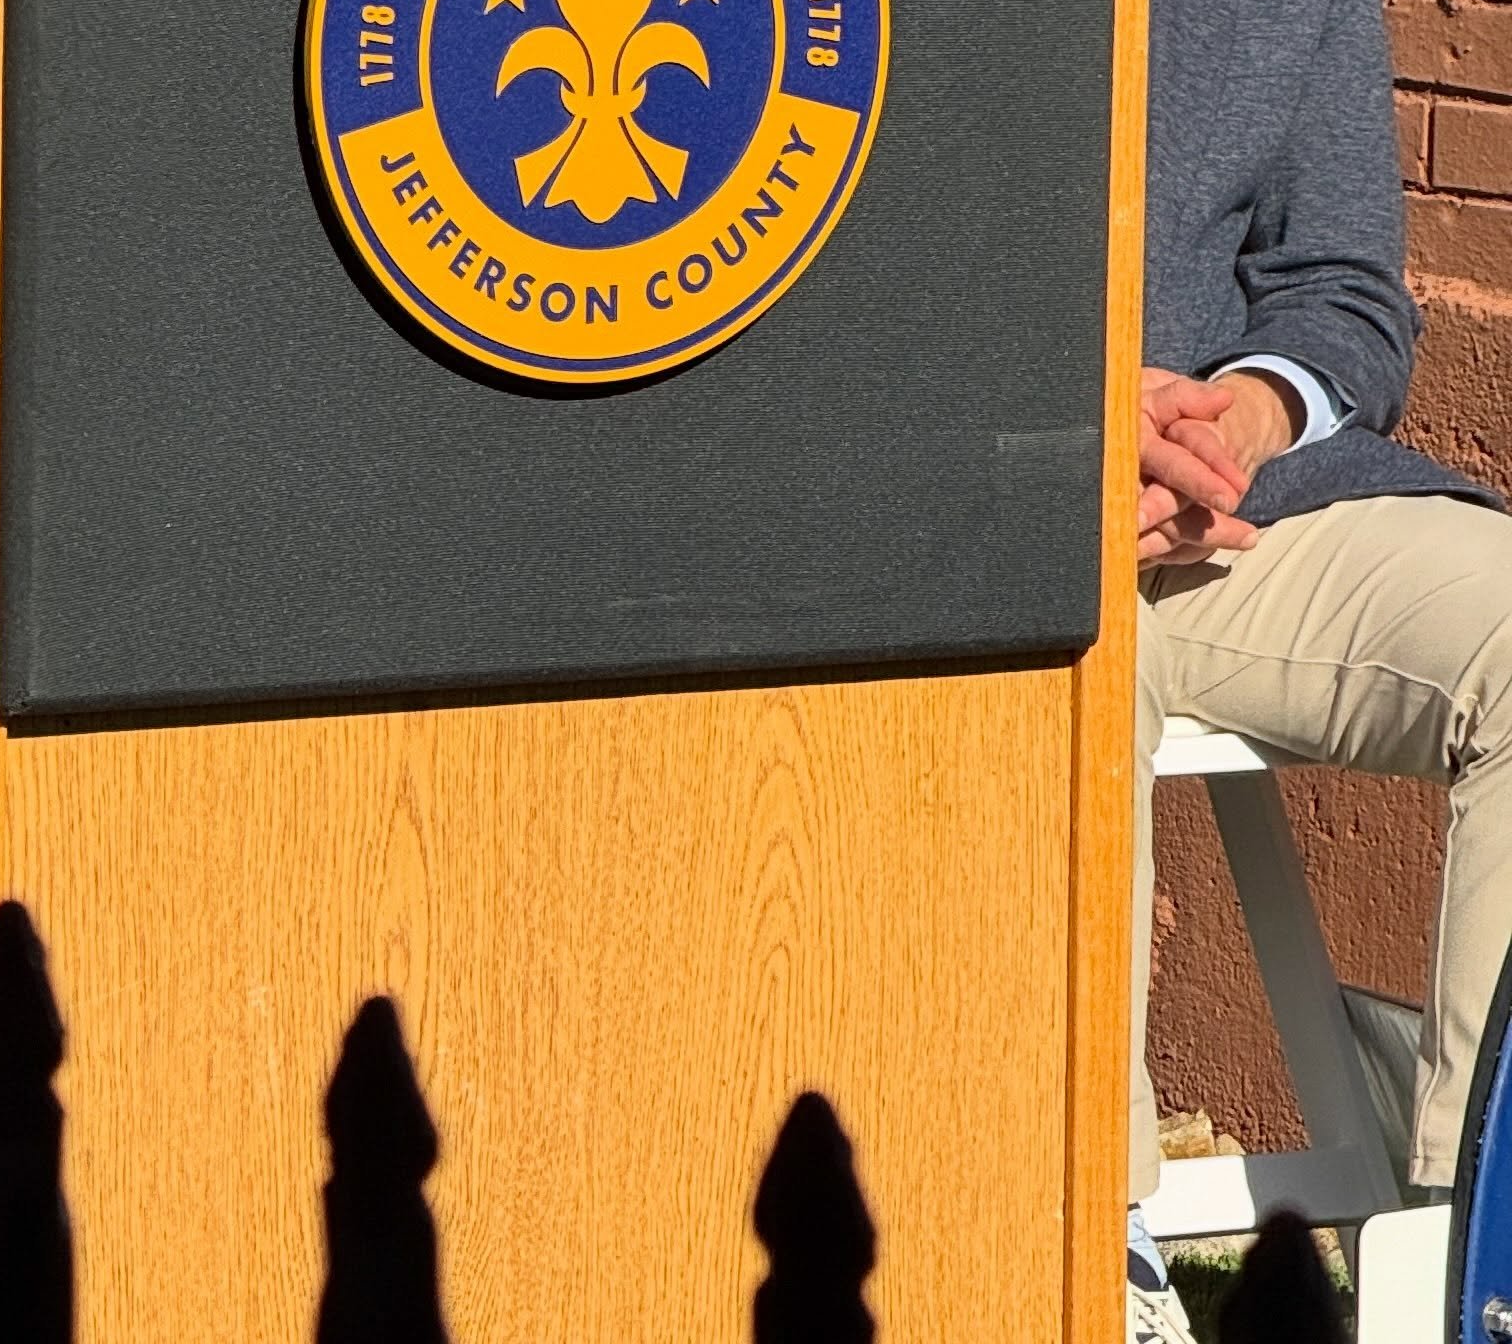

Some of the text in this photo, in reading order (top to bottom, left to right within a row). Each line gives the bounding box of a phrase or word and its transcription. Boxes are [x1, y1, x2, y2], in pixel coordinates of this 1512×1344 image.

[359, 4, 395, 86] 1778
[380, 122, 817, 324] JEFFERSON COUNTY
